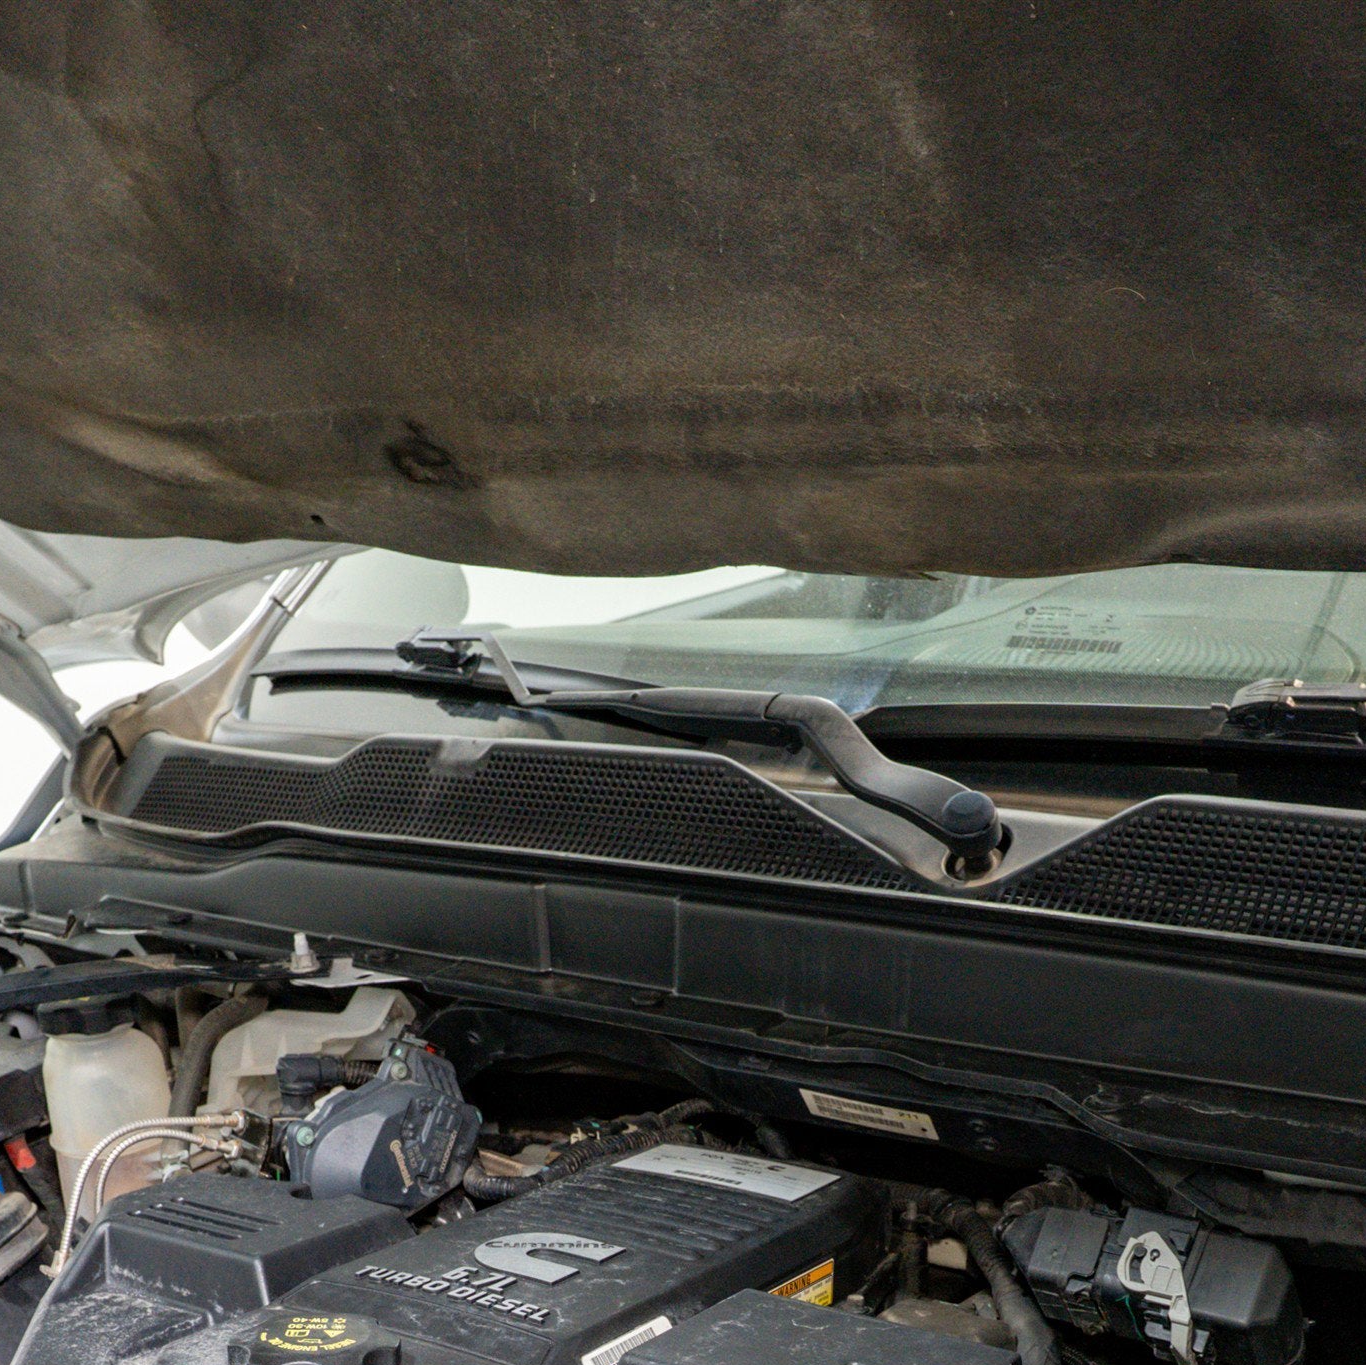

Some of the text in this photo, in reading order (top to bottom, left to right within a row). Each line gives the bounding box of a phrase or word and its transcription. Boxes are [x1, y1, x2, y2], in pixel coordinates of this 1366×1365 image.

[355, 1265, 550, 1325] TURBO DIESEL
[441, 1265, 518, 1295] 6.7L
